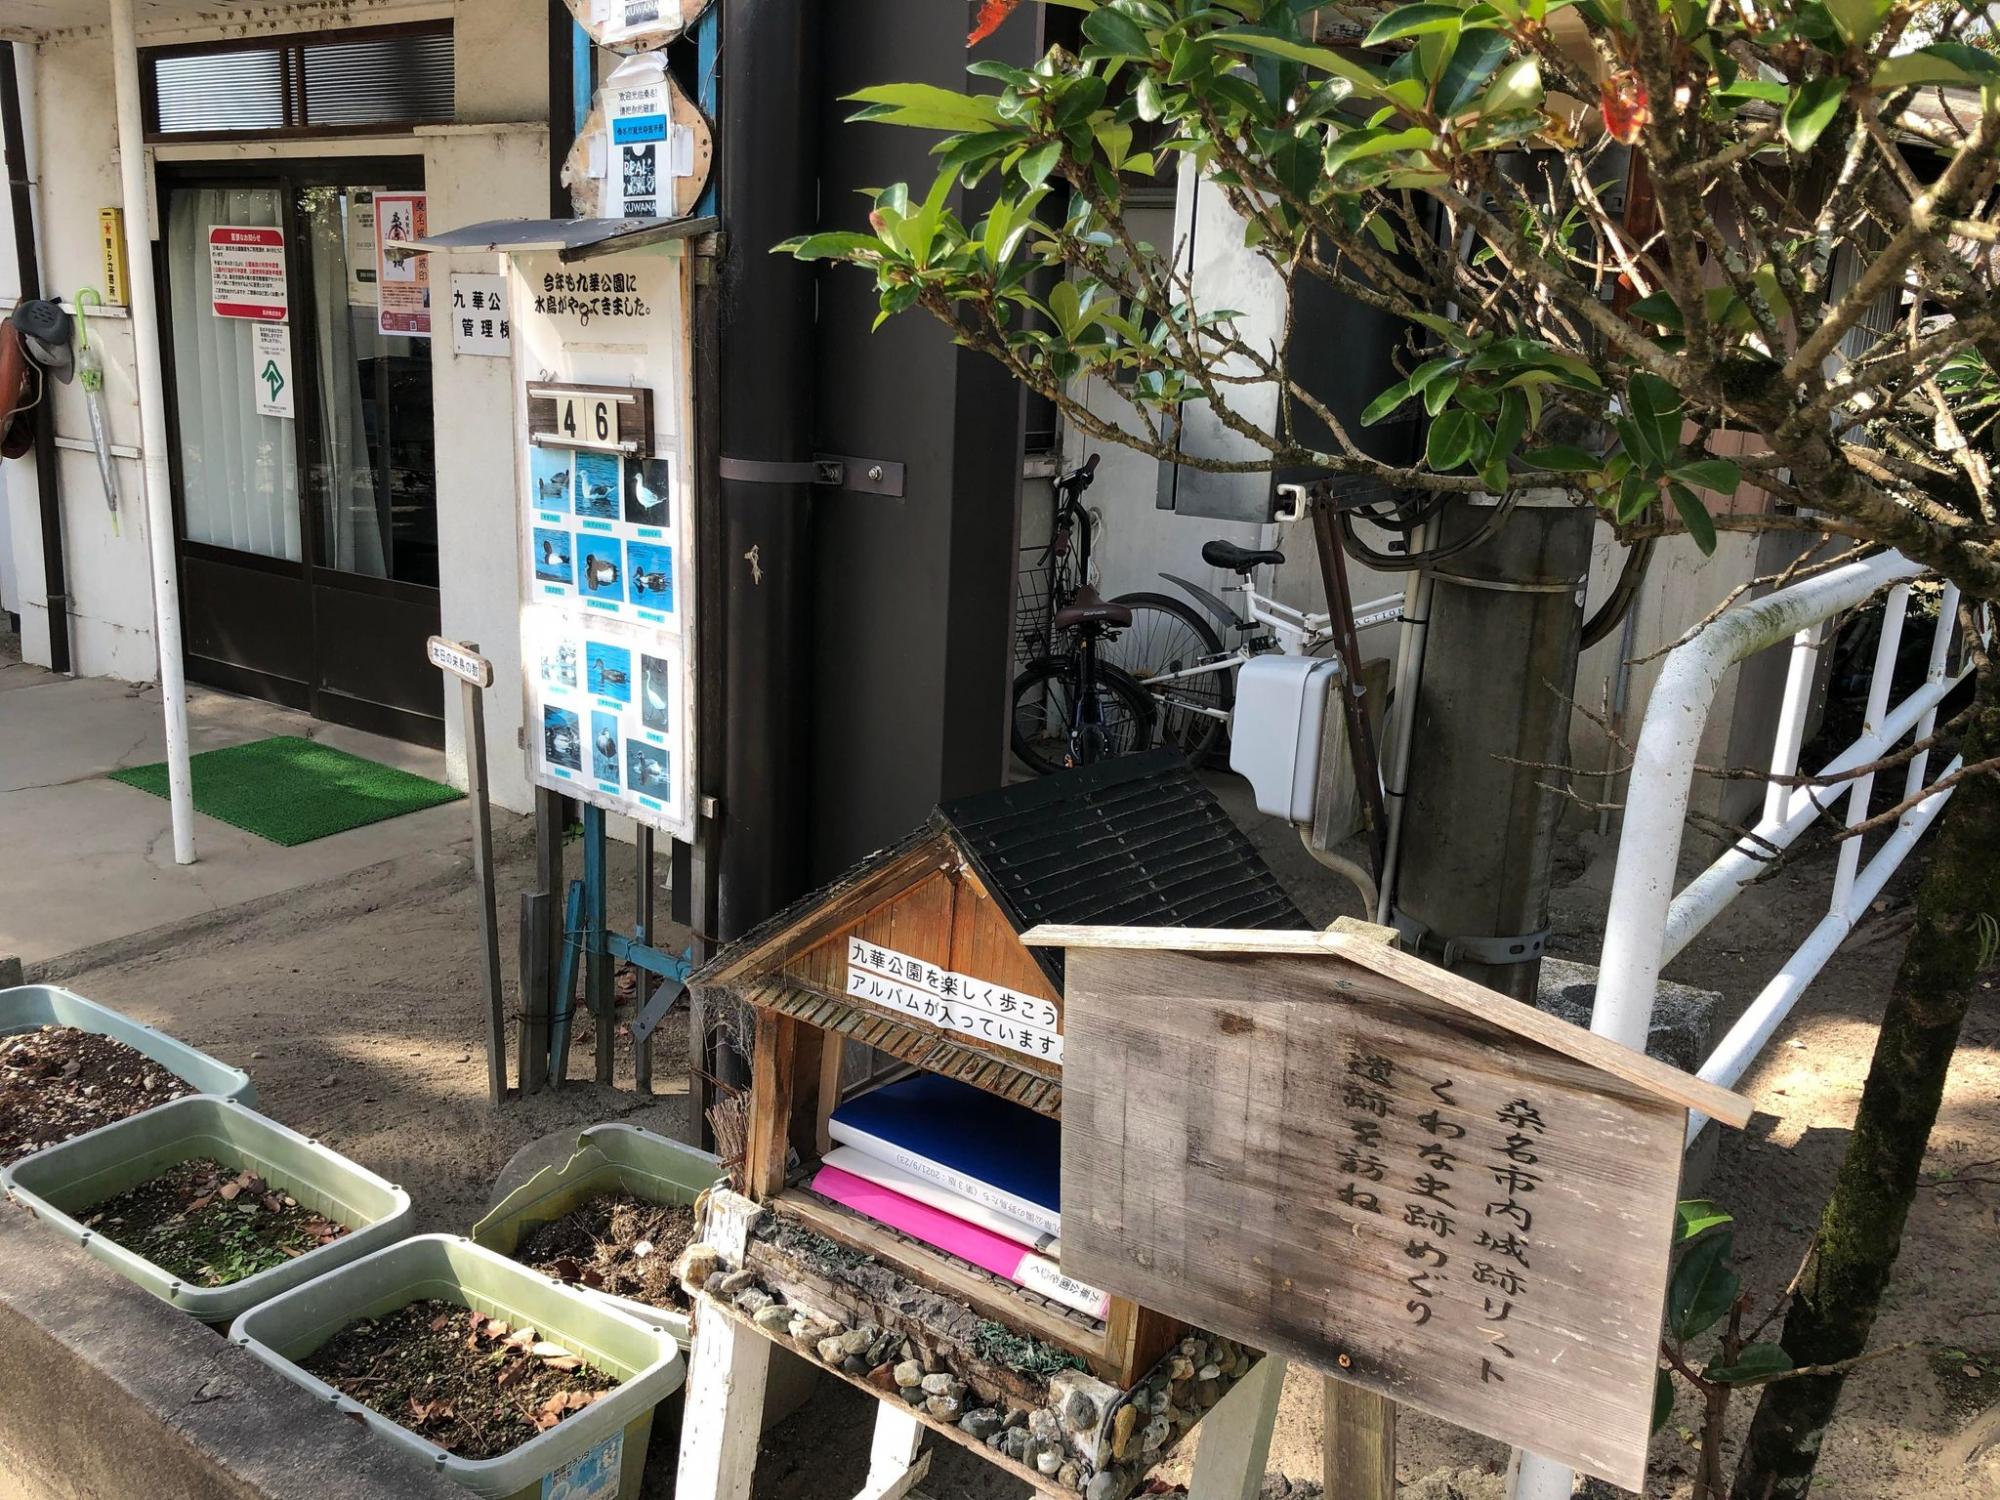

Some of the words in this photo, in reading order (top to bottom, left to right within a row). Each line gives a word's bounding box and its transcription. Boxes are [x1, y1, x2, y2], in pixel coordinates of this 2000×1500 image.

[624, 201, 656, 213] KUWANA
[543, 272, 637, 293] 今年も九華公園に
[852, 943, 1057, 1026] 九華公園を楽しく歩こう
[852, 974, 1064, 1062] アルバムが入っています。
[1403, 1079, 1467, 1327] くわな史跡めぐり
[1473, 1098, 1547, 1384] 桑名市内城跡リスト
